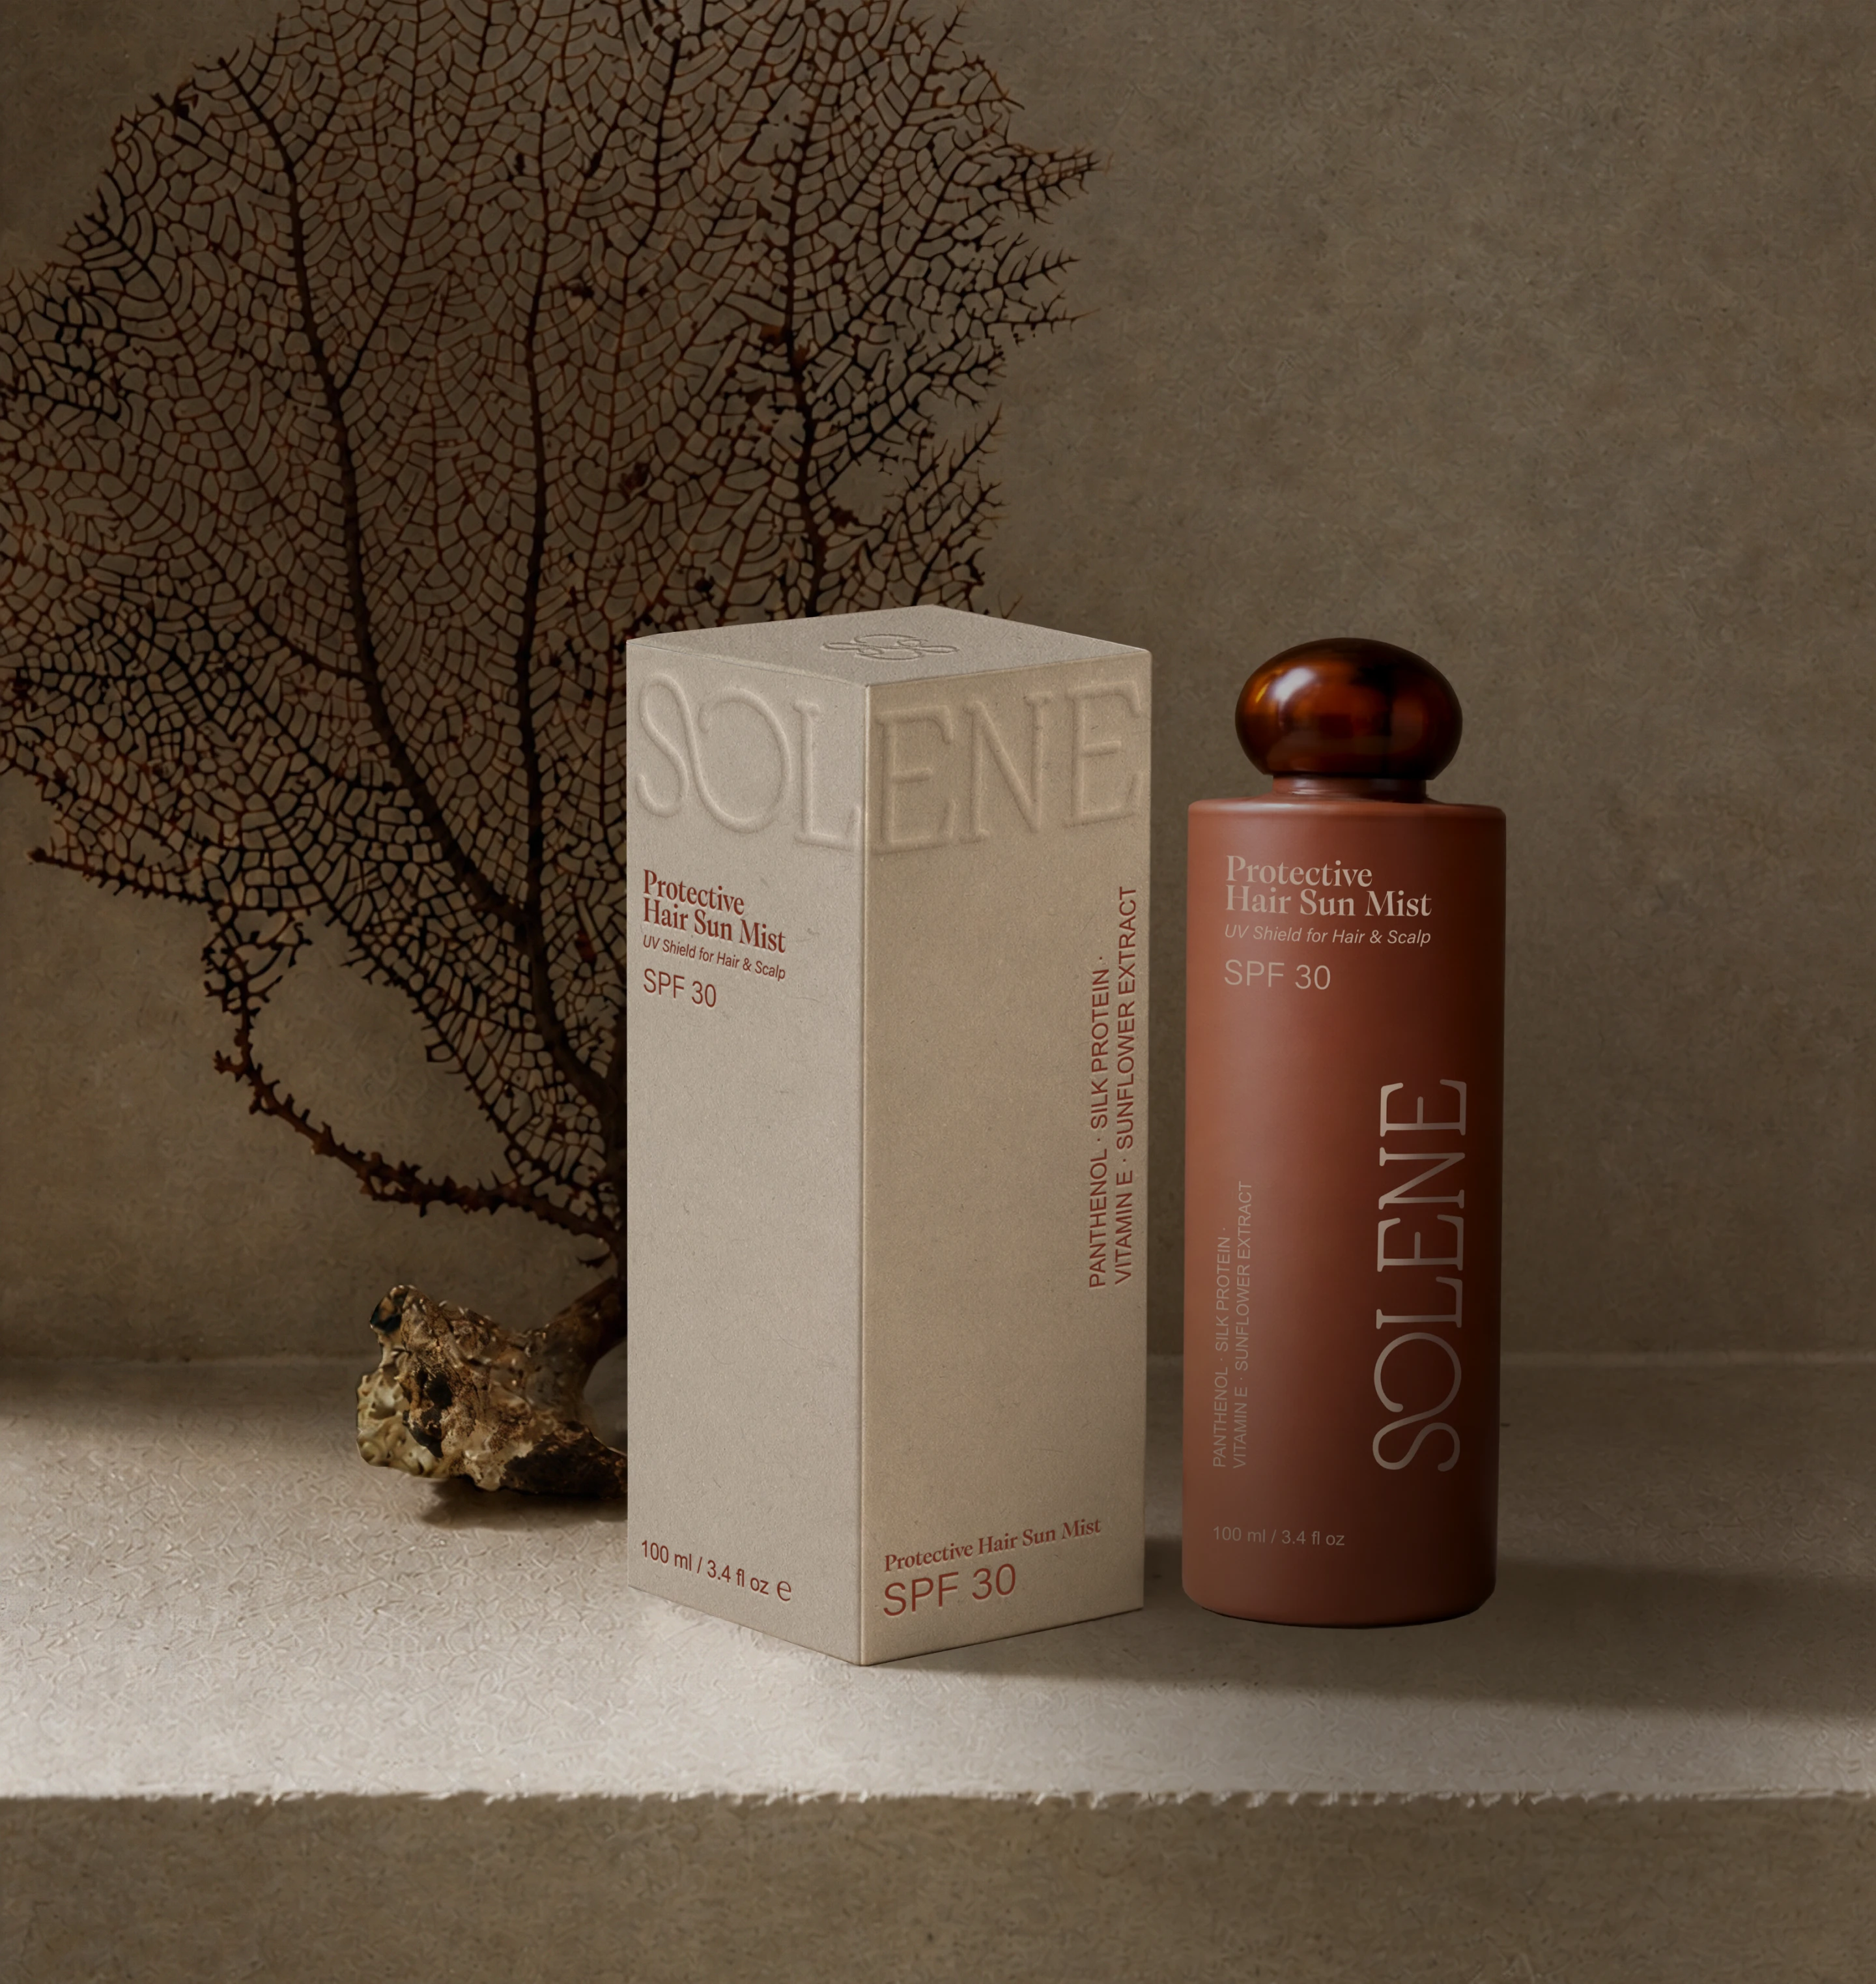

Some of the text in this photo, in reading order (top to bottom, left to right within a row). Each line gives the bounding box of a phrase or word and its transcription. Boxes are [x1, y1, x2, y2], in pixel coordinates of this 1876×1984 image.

[634, 672, 1144, 855] SOLENE
[644, 869, 745, 915] Protective
[1226, 855, 1372, 887] Protective
[644, 897, 786, 953] Hair Sun Mist
[1226, 884, 1432, 917] Hair Sun Mist
[643, 934, 786, 981] UV Shield for Hair & Scalp
[1118, 886, 1136, 995] EXTRACT
[1225, 924, 1432, 947] UV Shield for Hair & Scalp
[644, 968, 717, 1007] SPF 30
[1224, 959, 1331, 990] SPF 30
[1091, 969, 1109, 1072] PROTEIN
[1116, 1001, 1135, 1149] SUNFLOWER
[1090, 1078, 1108, 1129] SILK
[1116, 1170, 1133, 1186] E
[1089, 1149, 1107, 1287] PANTHENOL
[1115, 1192, 1132, 1285] VITAMIN
[1237, 1181, 1252, 1259] EXTRACT
[1216, 1237, 1230, 1310] PROTEIN
[1372, 1078, 1467, 1473] SOLENE
[1215, 1315, 1229, 1352] SILK
[1235, 1265, 1250, 1371] SUNFLOWER
[1213, 1367, 1228, 1467] PANTHENOL
[1234, 1387, 1247, 1397] E
[1233, 1402, 1247, 1469] VITAMIN
[884, 1518, 1102, 1572] Protective Hair Sun Mist
[1213, 1526, 1345, 1546] 100 ml / 3.4 fl oz
[642, 1540, 669, 1564] 100
[674, 1553, 692, 1571] ml
[697, 1557, 702, 1574] /
[707, 1560, 731, 1583] 3.4
[736, 1568, 745, 1587] fl
[750, 1577, 769, 1595] oz
[883, 1564, 1016, 1616] SPF 30
